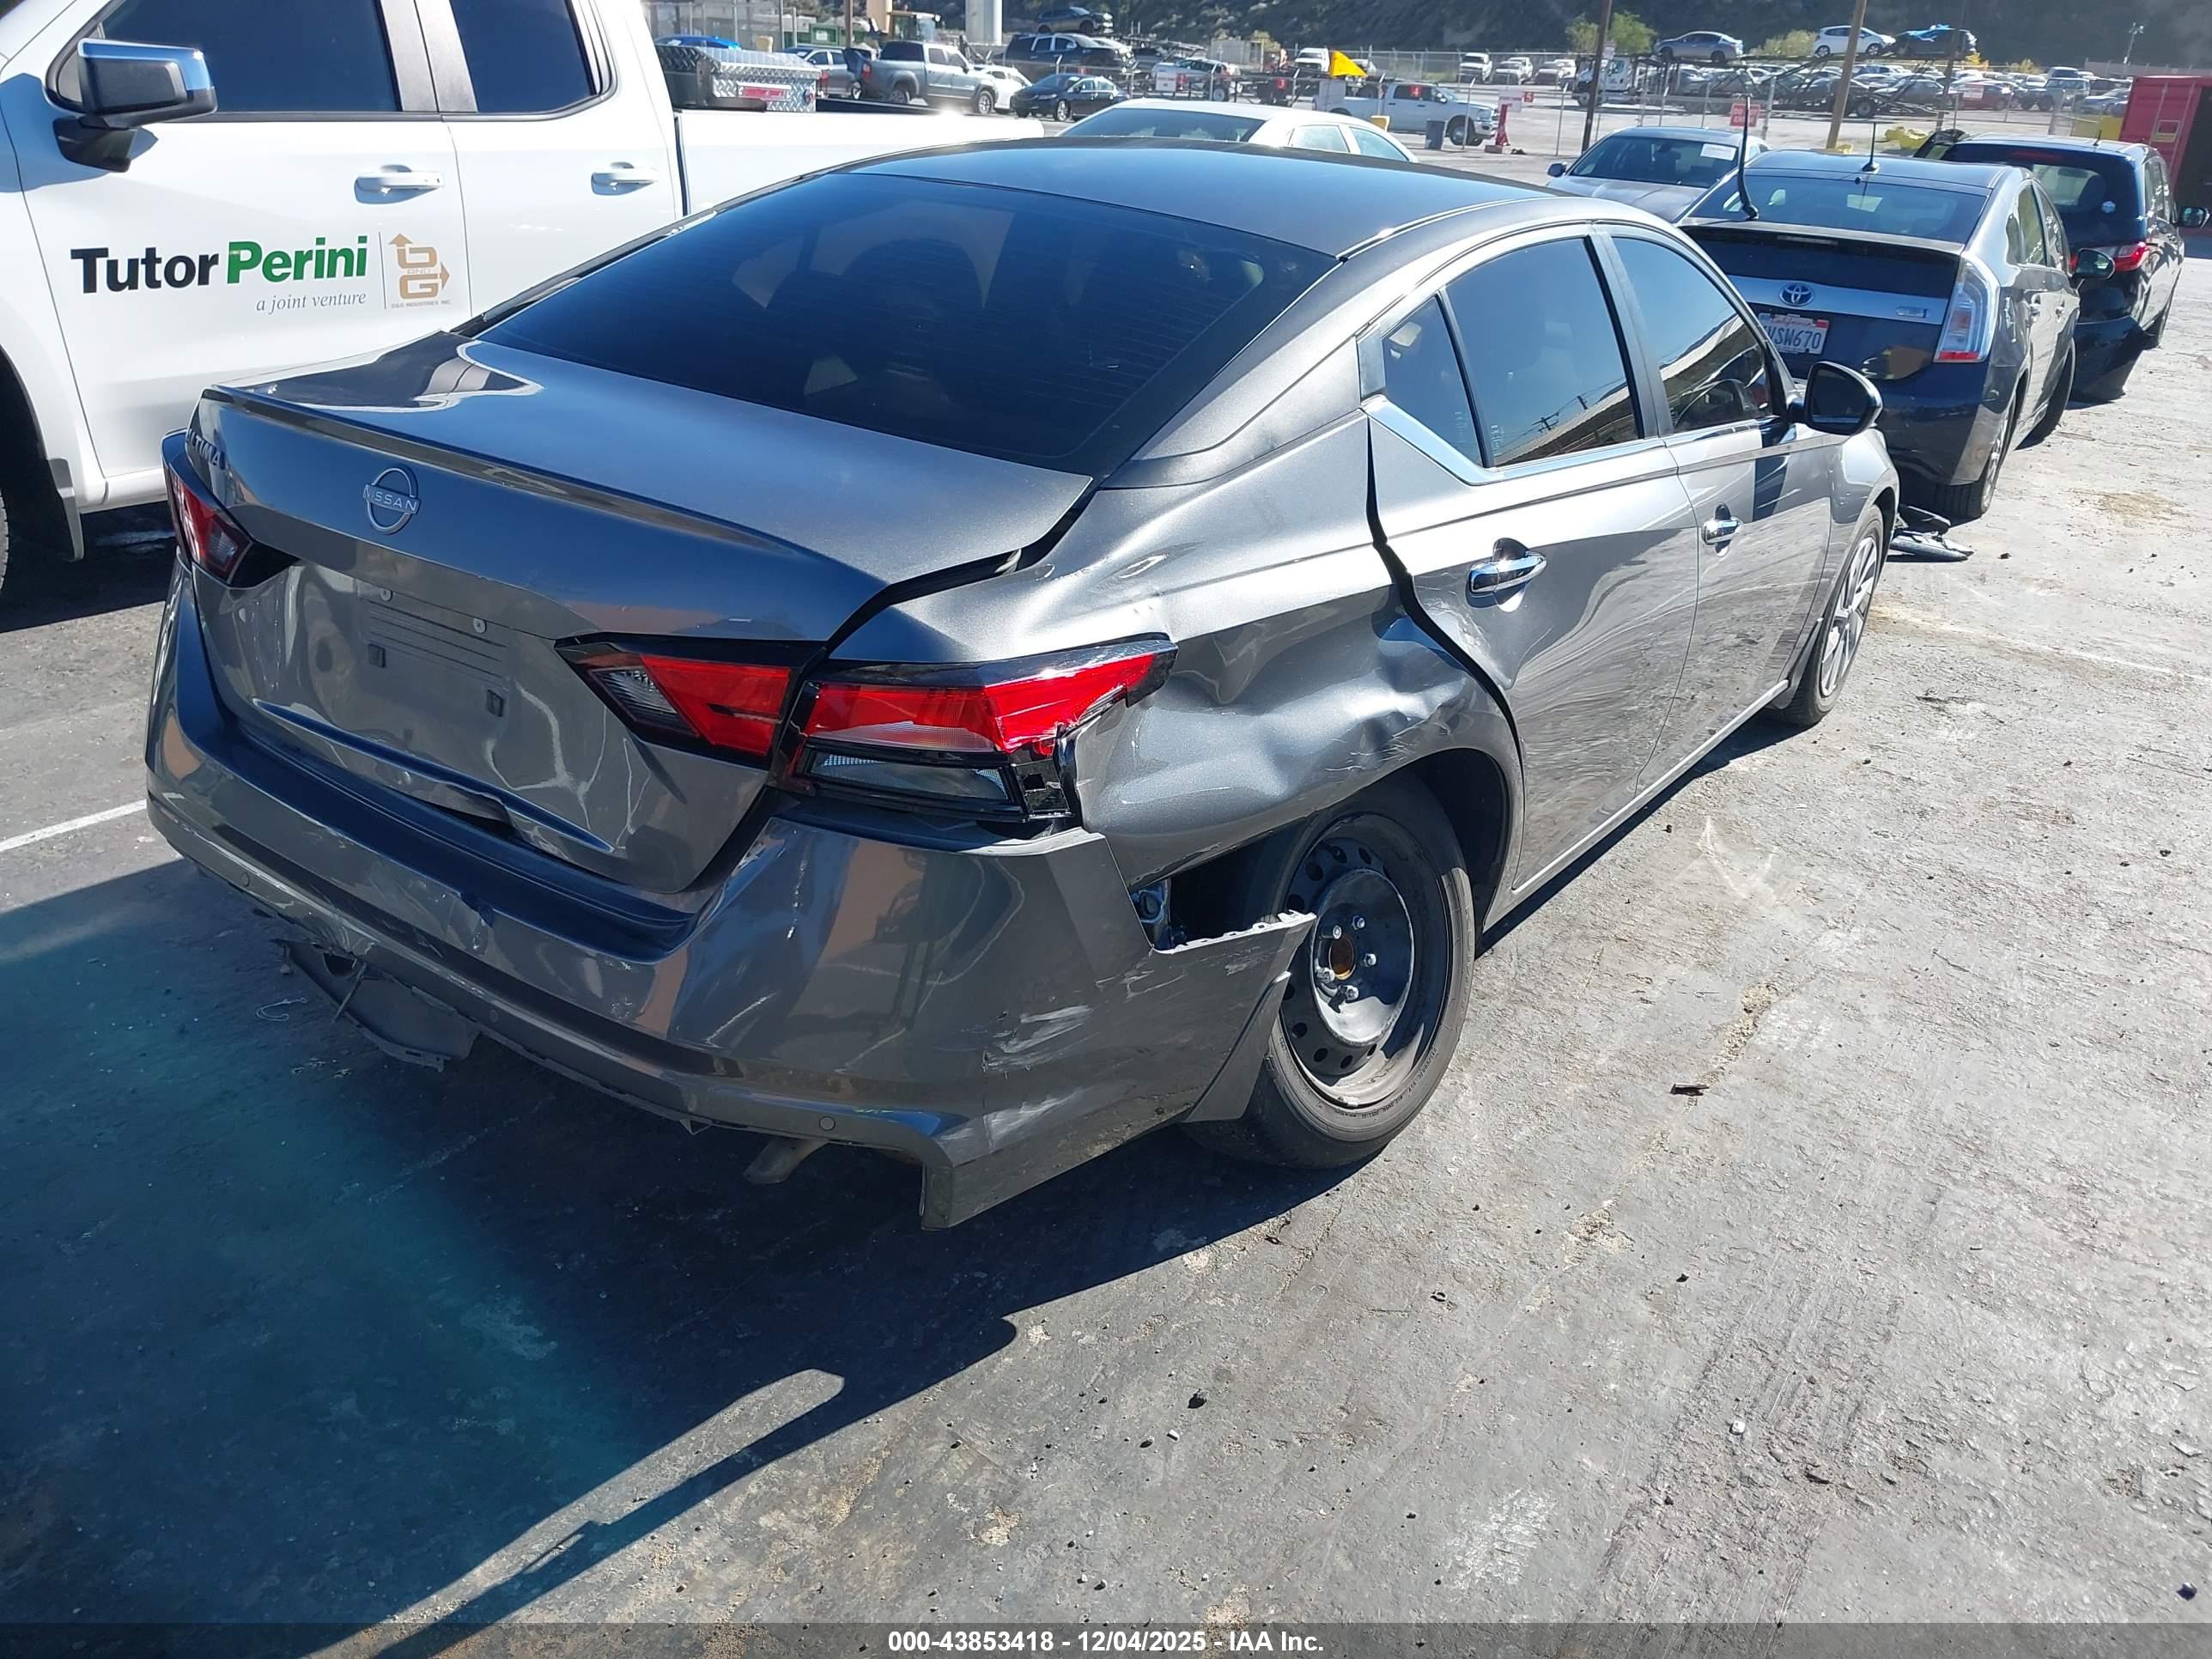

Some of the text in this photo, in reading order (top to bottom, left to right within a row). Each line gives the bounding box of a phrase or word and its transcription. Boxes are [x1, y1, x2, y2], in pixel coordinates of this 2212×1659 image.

[70, 235, 368, 294] Tutor Perini
[257, 292, 368, 315] a joint venture
[1765, 325, 1822, 349] VSW670
[362, 484, 418, 513] NISSAN
